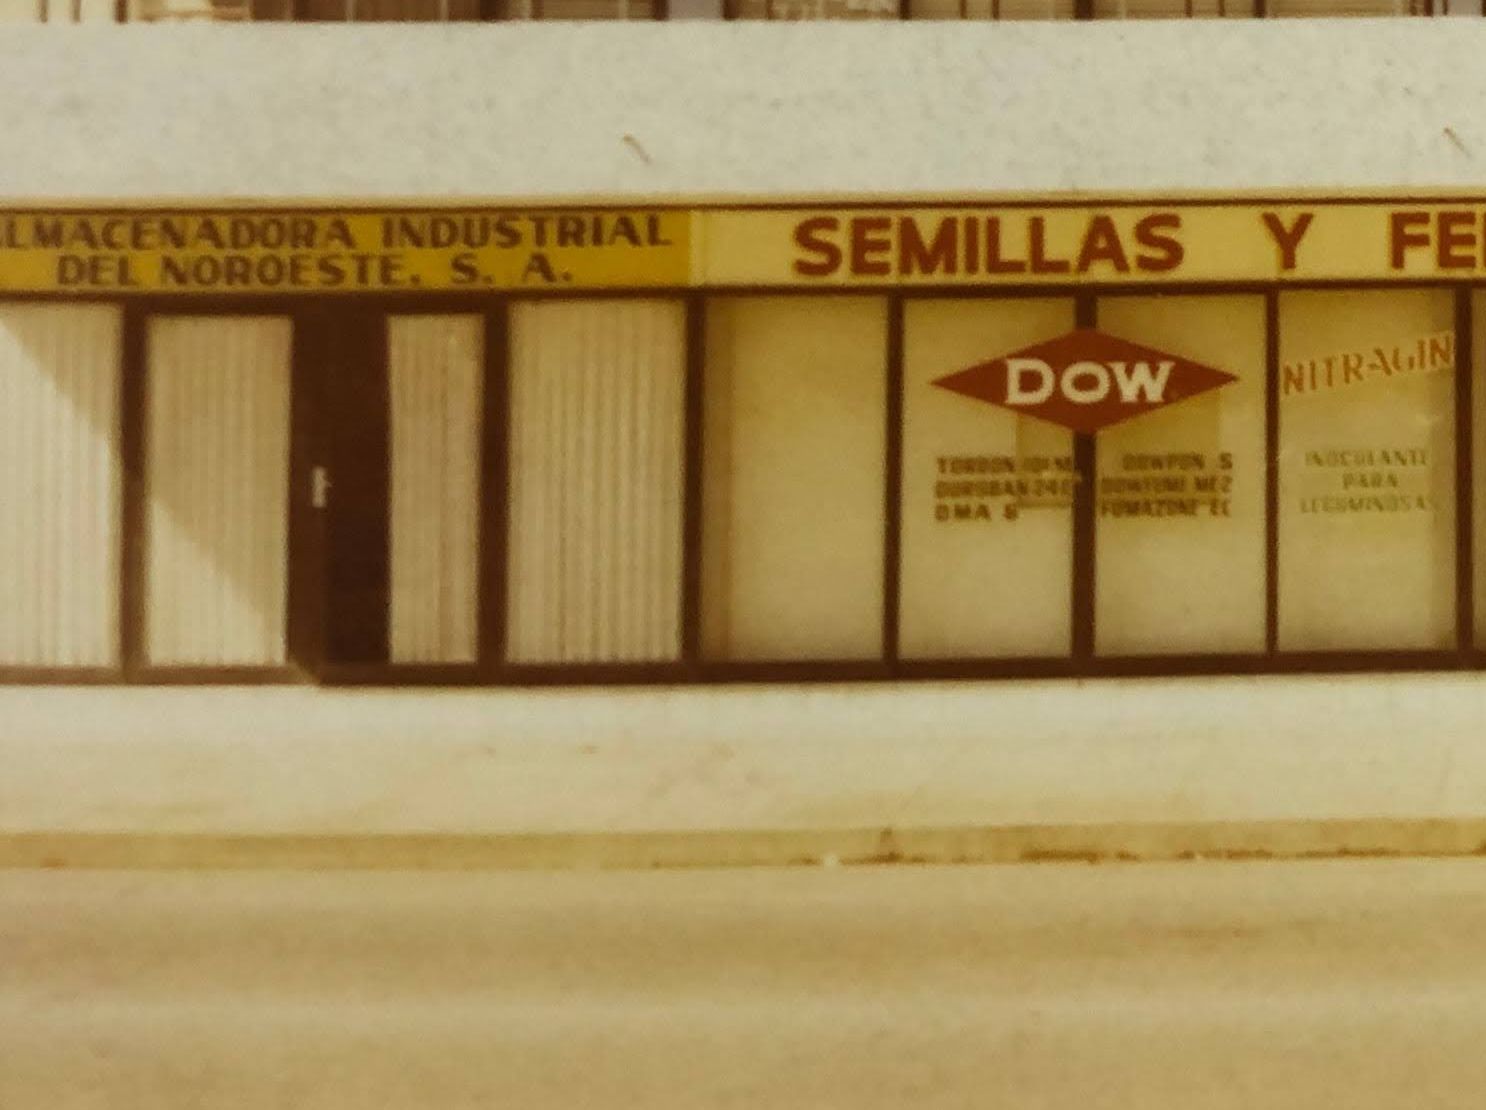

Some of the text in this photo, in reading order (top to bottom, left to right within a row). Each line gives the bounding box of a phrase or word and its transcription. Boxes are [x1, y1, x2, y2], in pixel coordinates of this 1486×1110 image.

[0, 215, 672, 251] LMACENADORA INDUSTRIAL
[794, 215, 1184, 275] SEMILLAS
[1263, 213, 1314, 270] Y
[57, 254, 135, 285] DEL
[1004, 357, 1175, 406] DOW
[1283, 334, 1452, 394] NITRAGIN
[1342, 473, 1399, 490] PARA
